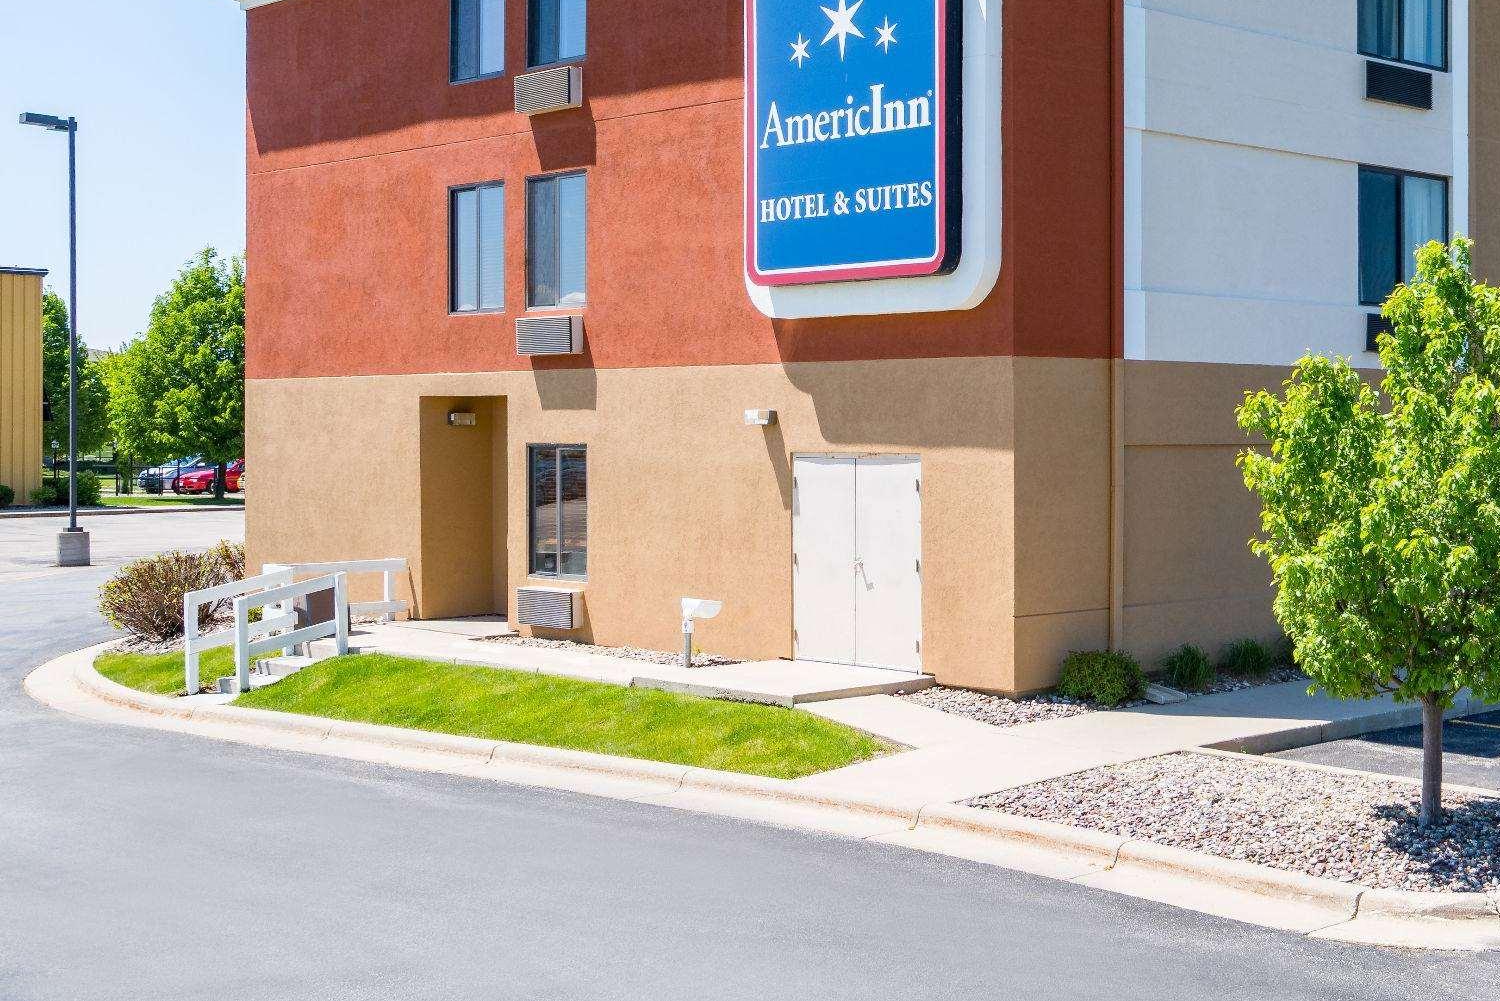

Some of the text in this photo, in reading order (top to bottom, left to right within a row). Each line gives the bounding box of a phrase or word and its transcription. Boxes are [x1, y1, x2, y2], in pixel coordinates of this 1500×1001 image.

[760, 83, 932, 149] AmericInn
[760, 181, 933, 222] HOTEL & SUITES
